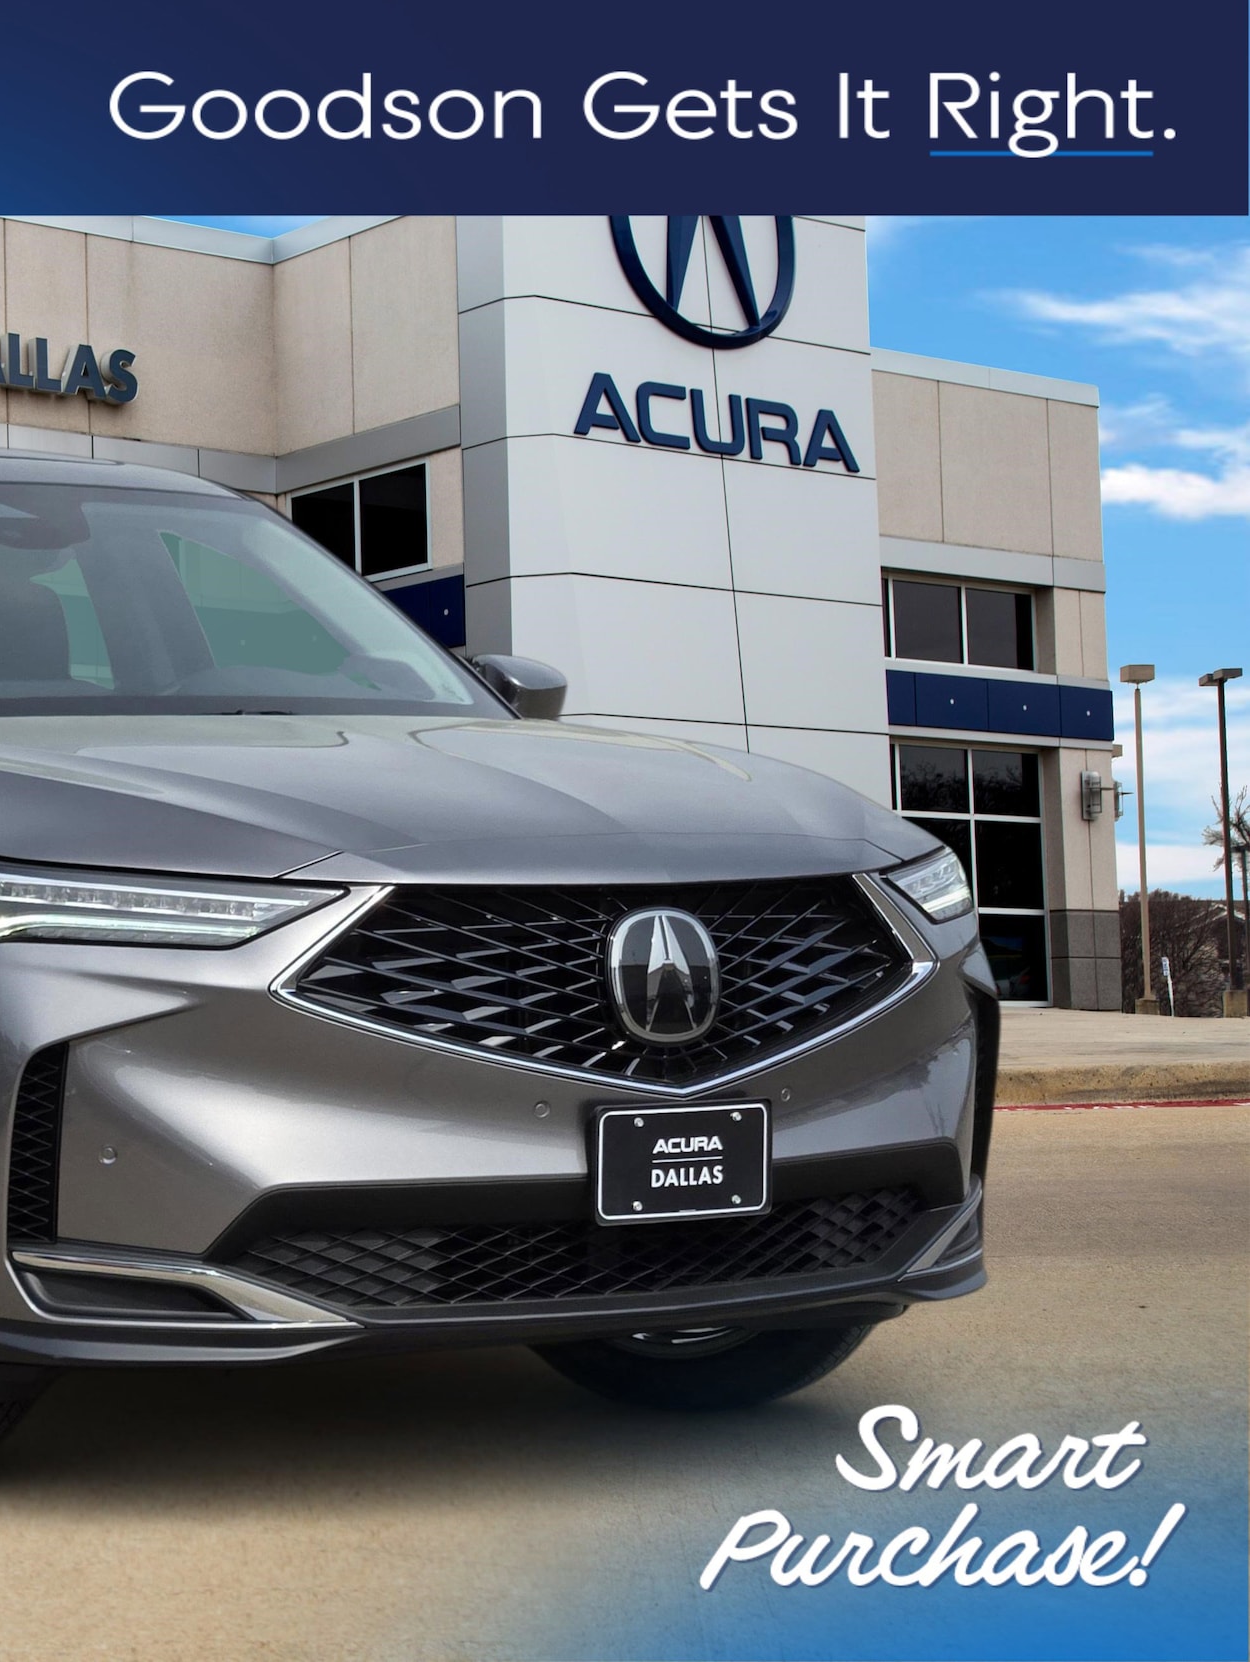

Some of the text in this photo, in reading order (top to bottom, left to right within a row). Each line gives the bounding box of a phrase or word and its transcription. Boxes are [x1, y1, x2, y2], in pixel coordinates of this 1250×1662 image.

[573, 372, 860, 473] ACURA
[652, 1136, 723, 1154] ACURA
[651, 1165, 724, 1188] DALLAS
